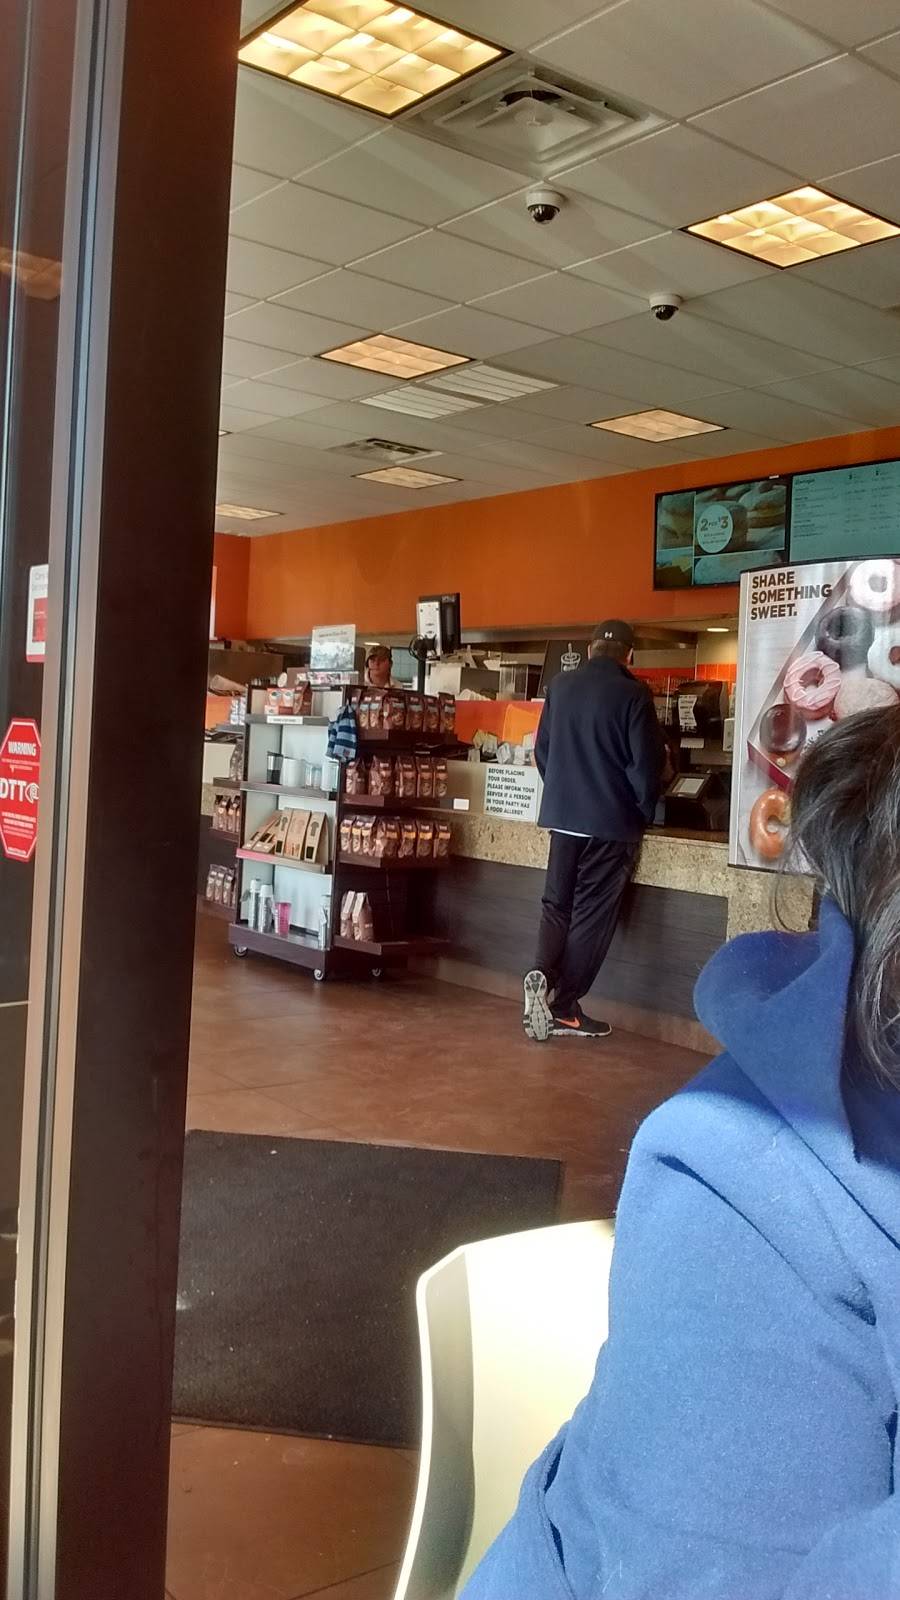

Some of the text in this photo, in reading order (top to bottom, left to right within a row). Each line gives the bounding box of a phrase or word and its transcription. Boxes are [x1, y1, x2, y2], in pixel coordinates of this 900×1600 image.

[700, 518, 709, 532] 2
[752, 571, 795, 589] SHARE
[751, 584, 833, 605] SOMETHING
[750, 603, 798, 620] SWEET.
[8, 741, 37, 757] WARNING
[504, 784, 521, 792] INFORM
